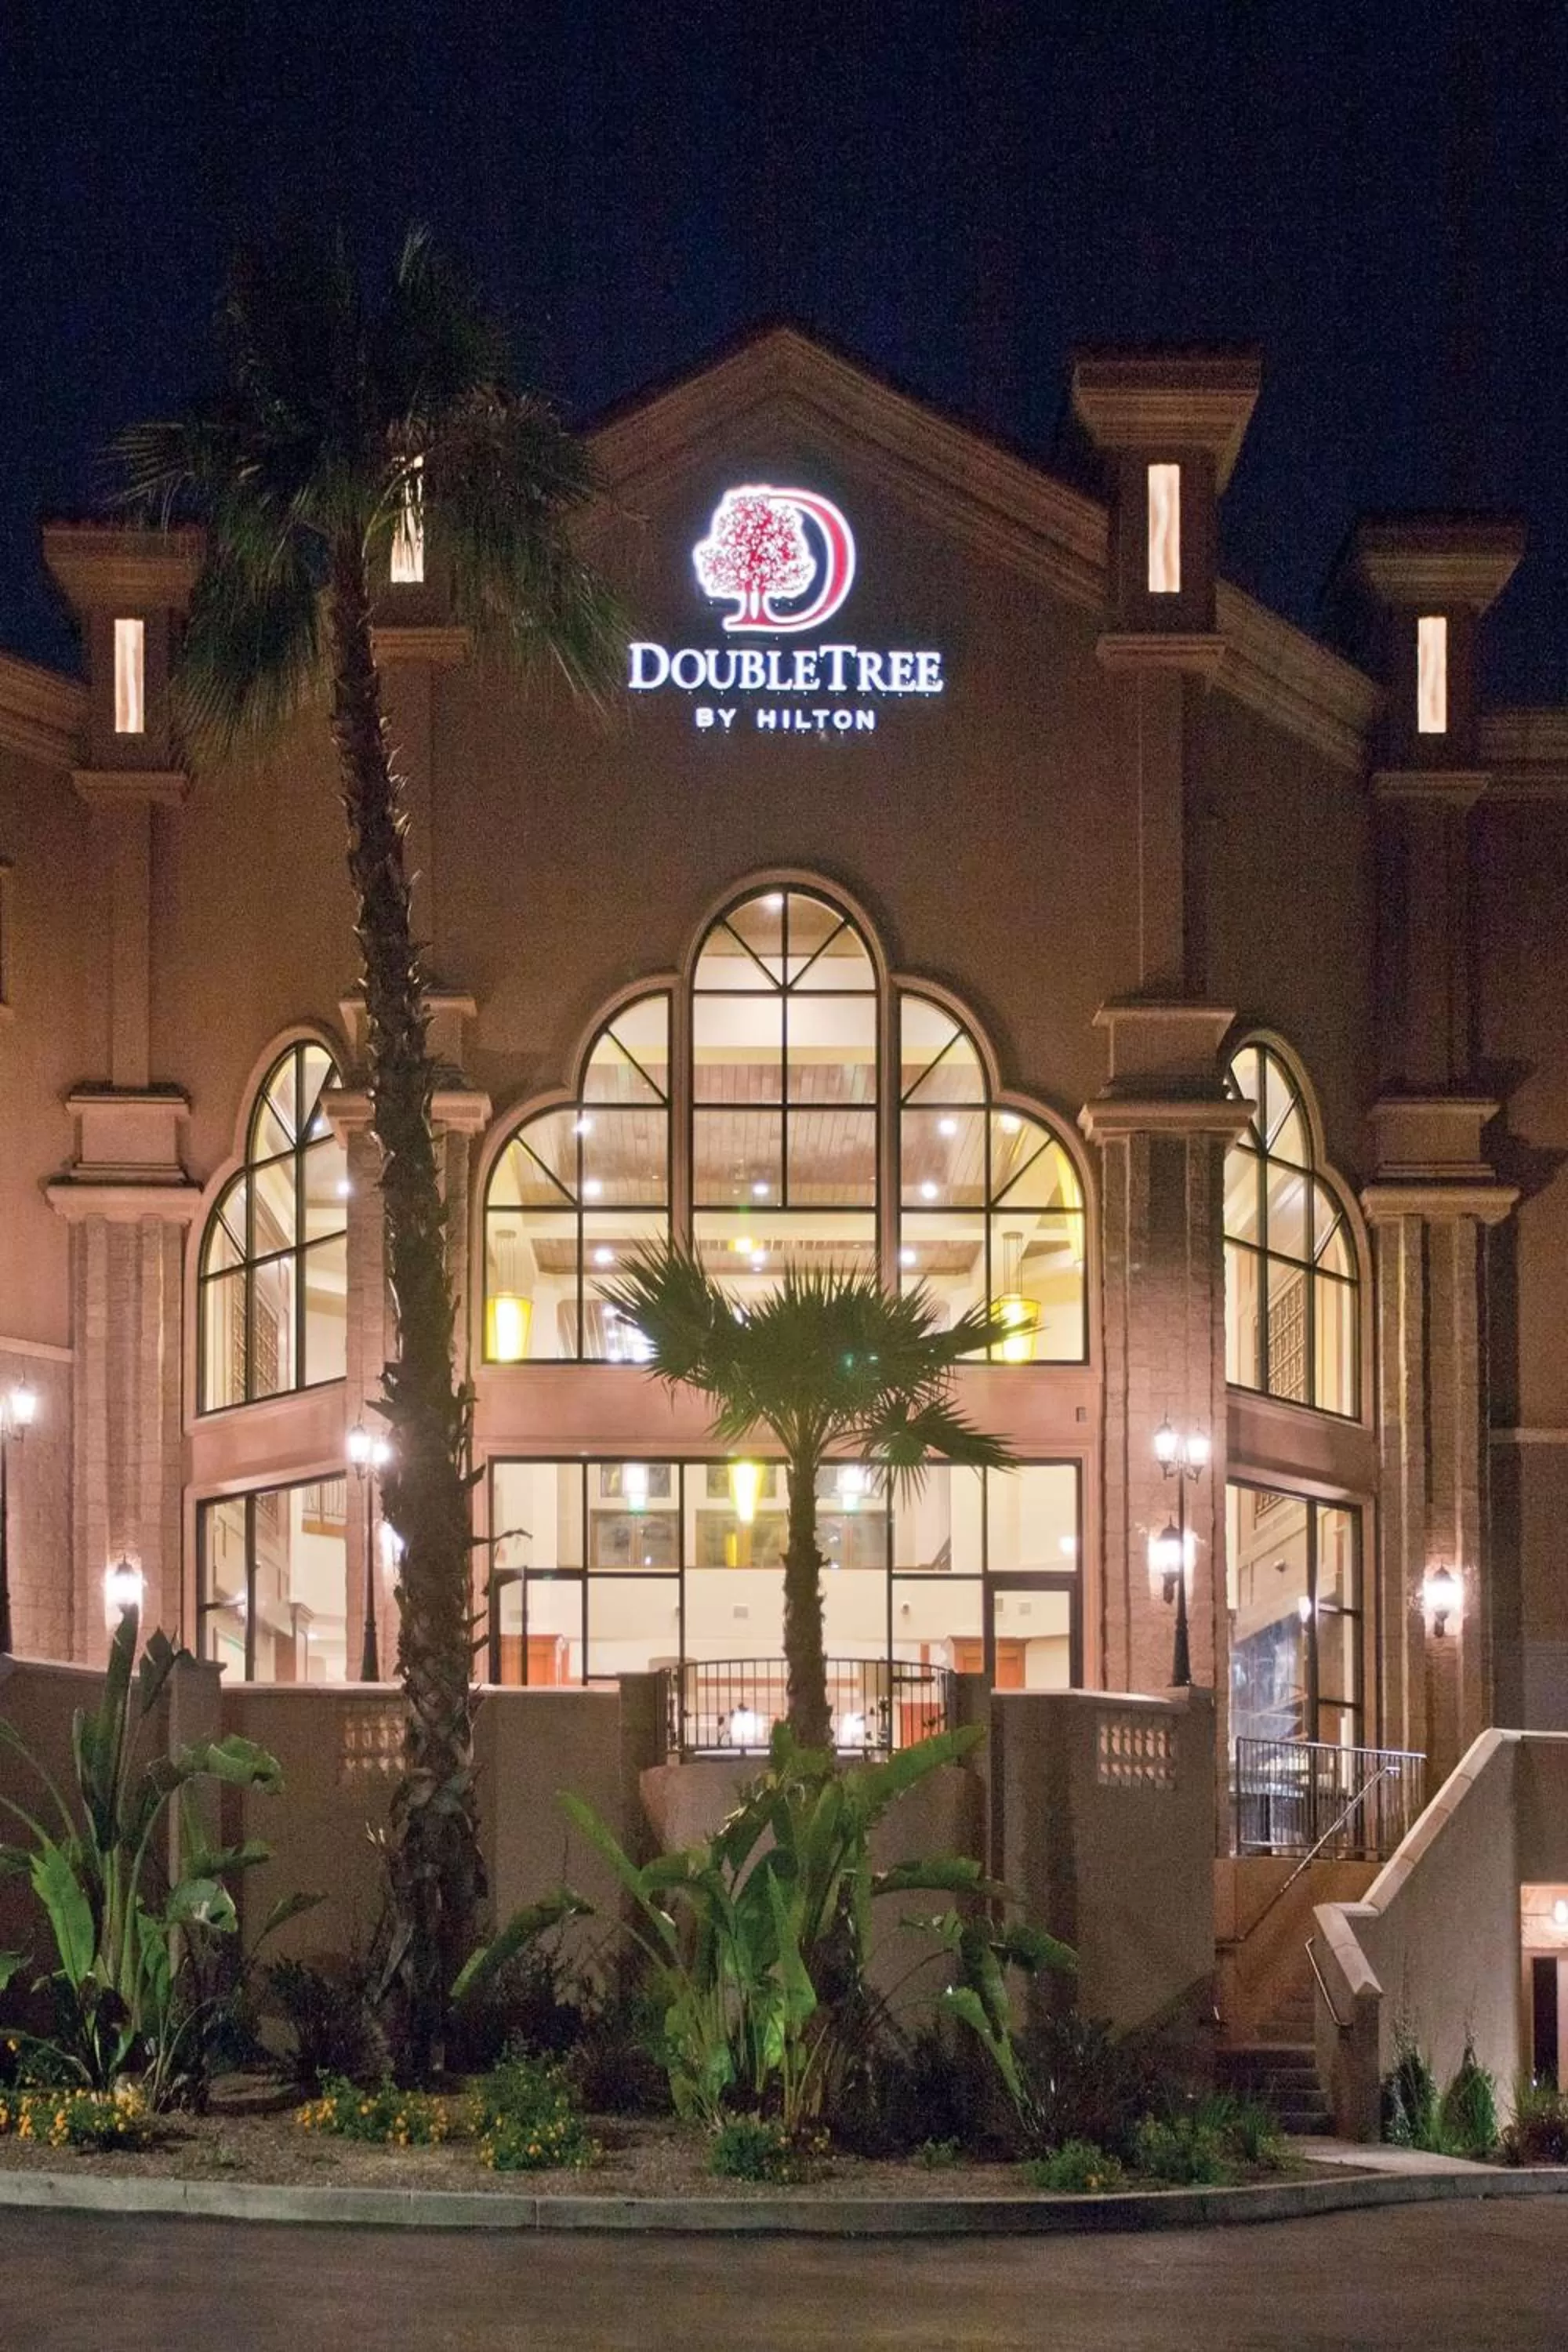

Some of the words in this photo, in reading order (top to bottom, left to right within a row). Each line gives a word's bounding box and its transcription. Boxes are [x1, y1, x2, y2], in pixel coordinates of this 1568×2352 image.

[628, 642, 944, 692] DOUBLETREE
[695, 707, 736, 728] BY
[757, 708, 876, 730] HILTON
